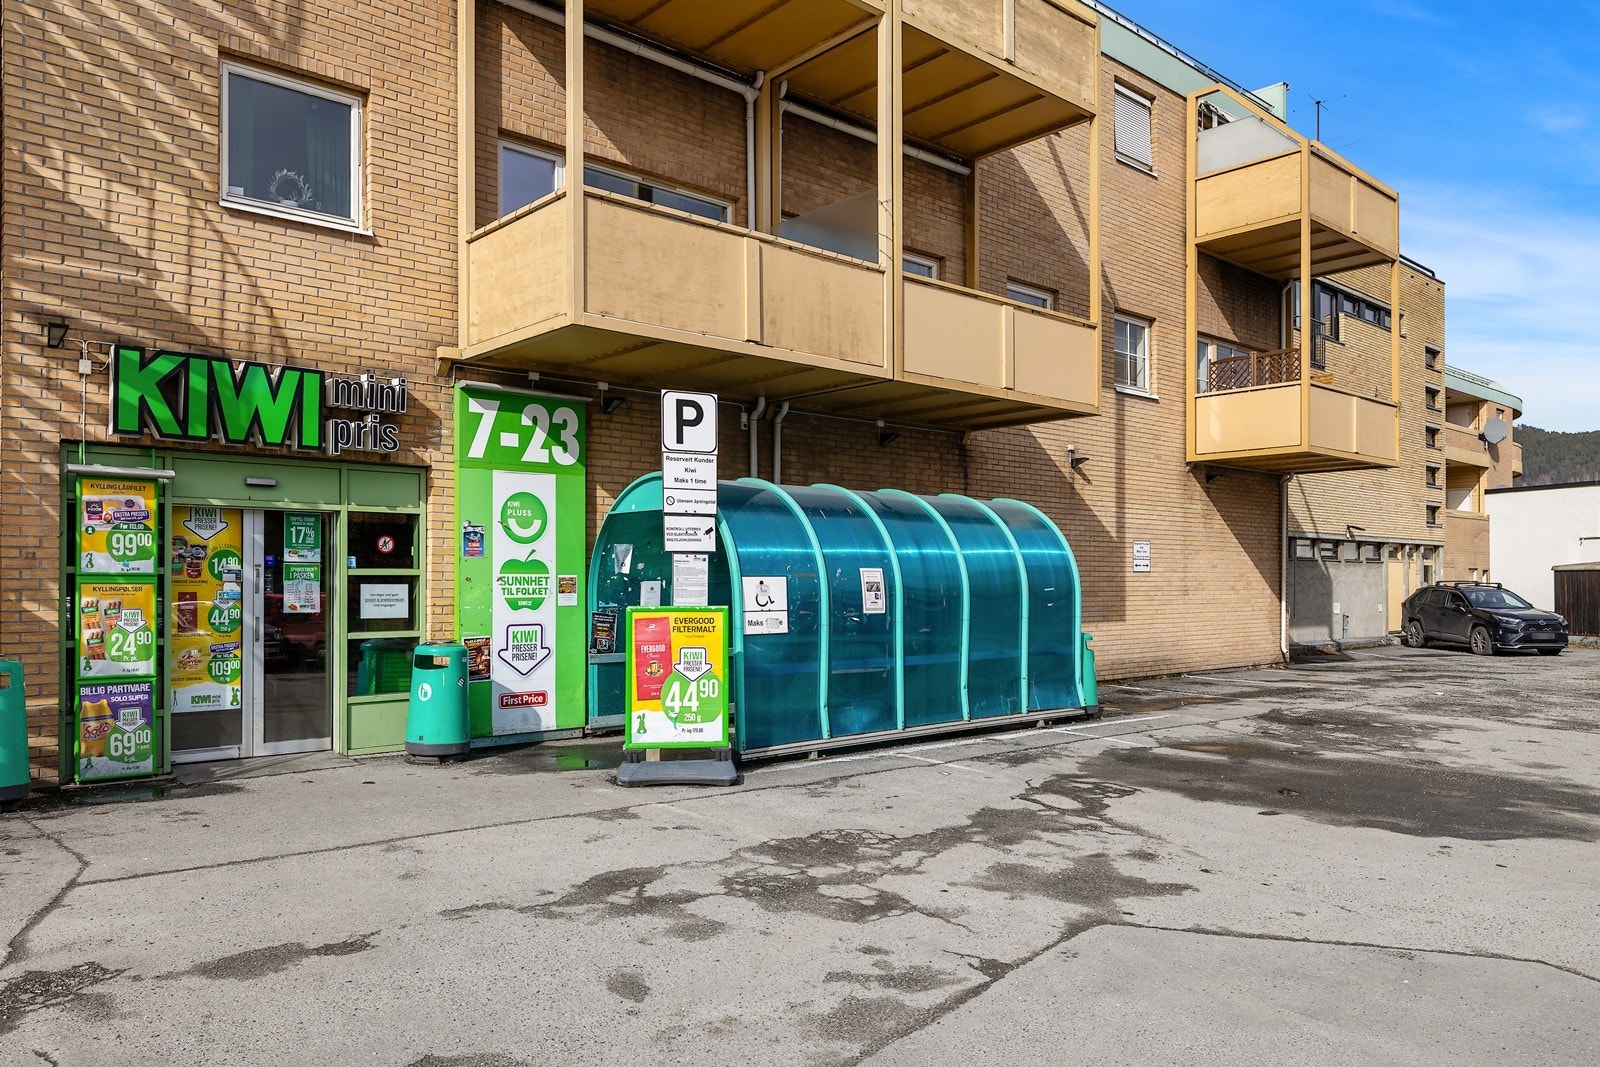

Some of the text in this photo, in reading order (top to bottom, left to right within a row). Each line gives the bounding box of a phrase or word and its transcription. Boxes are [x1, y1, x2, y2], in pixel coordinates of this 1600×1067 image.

[113, 344, 325, 450] KIWI
[332, 373, 408, 413] mini
[676, 398, 704, 444] P
[332, 414, 400, 455] pris
[467, 398, 580, 466] 7-23
[194, 507, 217, 517] KIWI
[293, 571, 314, 579] PÅSKEN
[501, 576, 550, 586] SUNNHET
[501, 588, 514, 596] TIL
[512, 630, 538, 643] KIWI
[512, 644, 538, 652] PRESSER
[641, 645, 666, 653] EVERGOOD
[512, 652, 538, 662] PRISENE!
[80, 683, 150, 696] BILLIG PARTIVARE
[191, 695, 211, 704] KIWI
[503, 694, 543, 705] First Price
